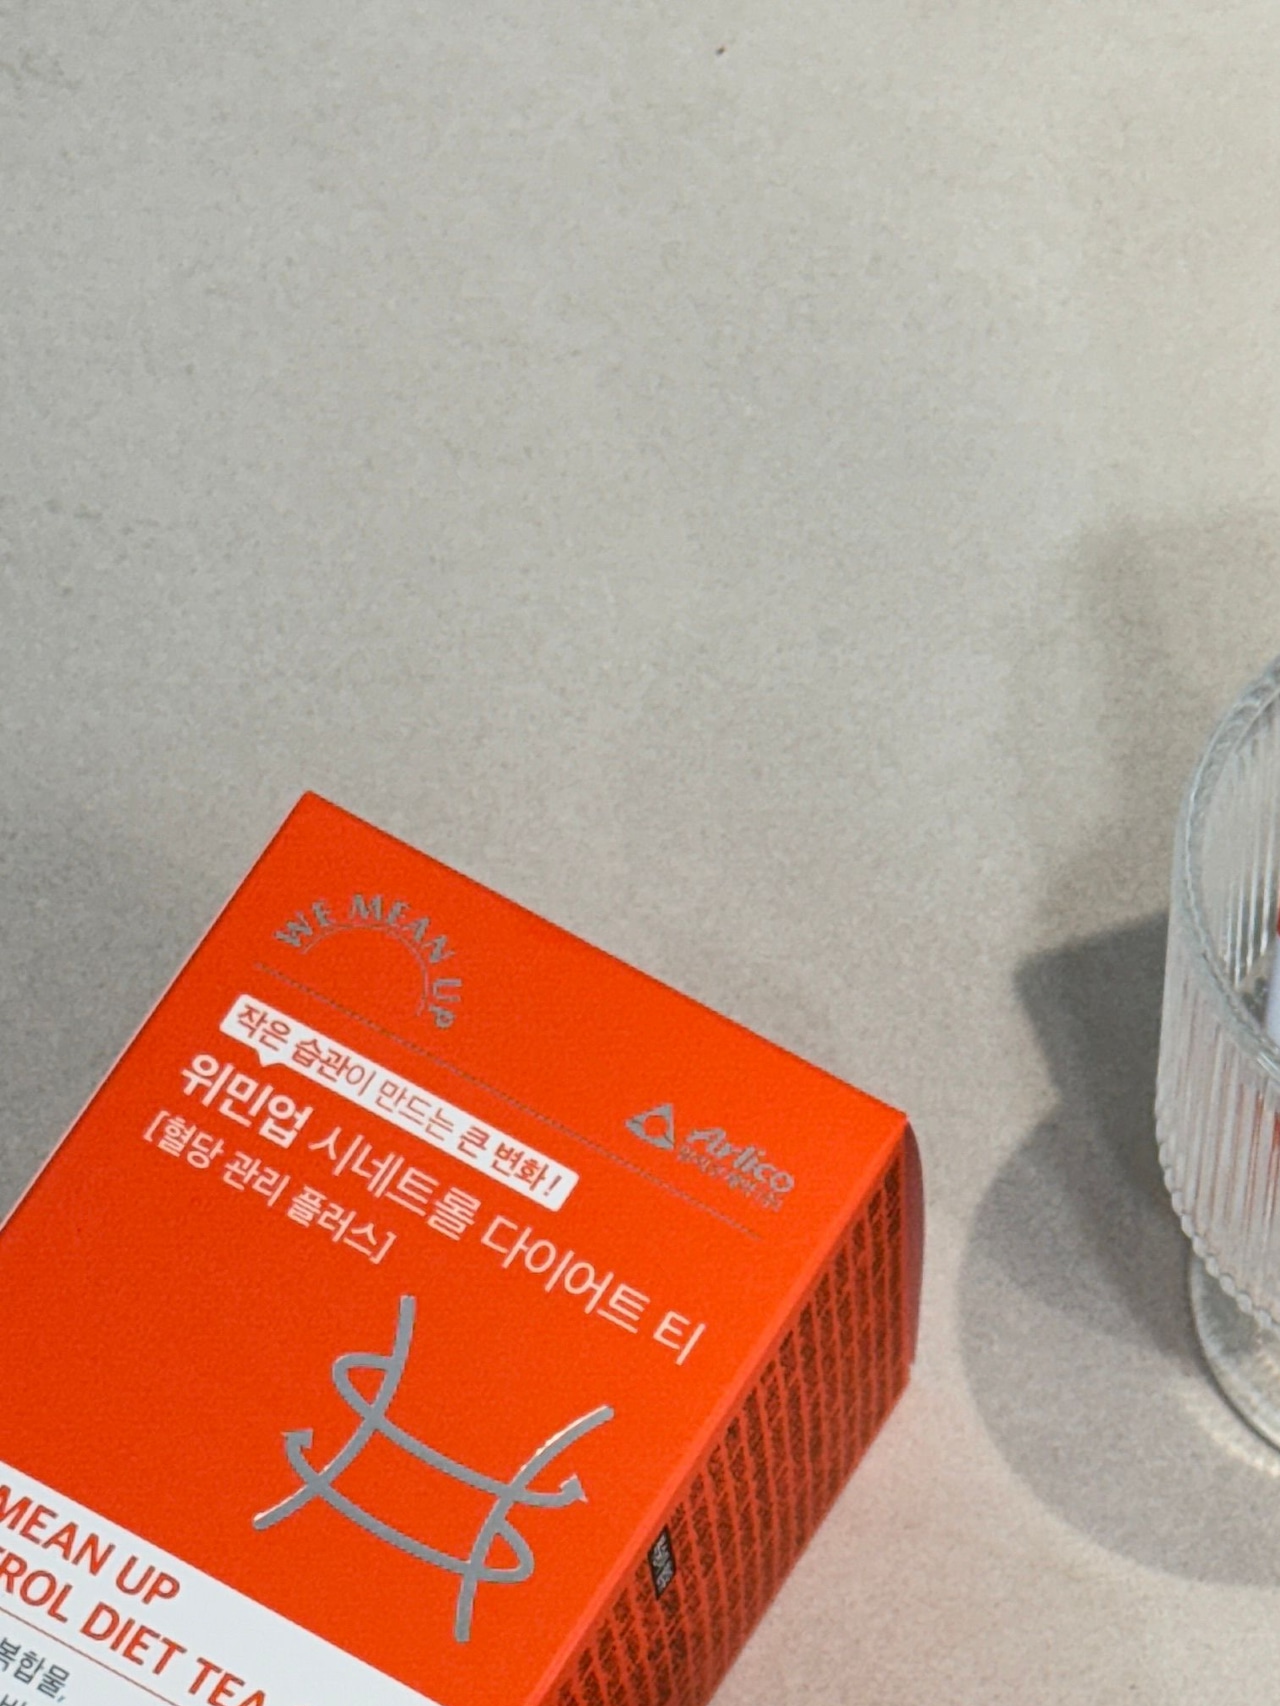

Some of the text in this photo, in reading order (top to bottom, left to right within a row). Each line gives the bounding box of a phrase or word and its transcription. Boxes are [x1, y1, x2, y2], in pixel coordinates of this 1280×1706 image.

[273, 894, 462, 1028] WE MEAN UP
[237, 1003, 290, 1051] 작은
[291, 1038, 377, 1097] 습관이
[374, 1079, 454, 1141] 만드는
[457, 1124, 489, 1159] 큰
[181, 1054, 706, 1366] 위민업 시네트롤 다이어트 티
[222, 1151, 291, 1208] 관리
[0, 1546, 73, 1624] ROL
[79, 1600, 188, 1676] DIET
[116, 1555, 180, 1605] UP
